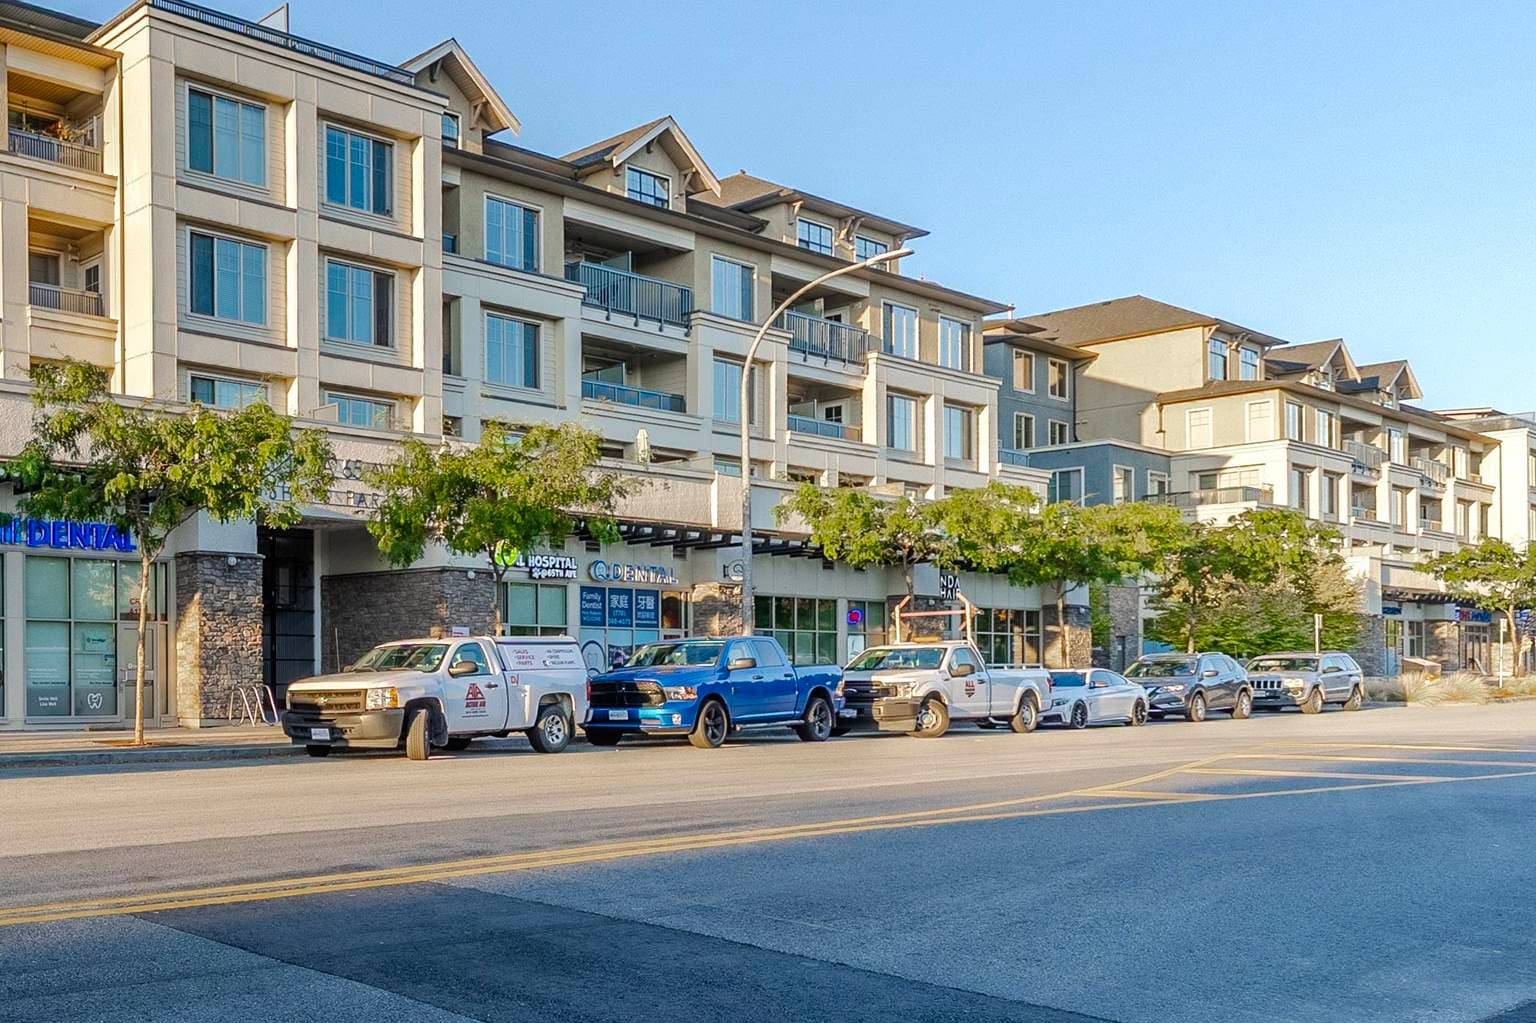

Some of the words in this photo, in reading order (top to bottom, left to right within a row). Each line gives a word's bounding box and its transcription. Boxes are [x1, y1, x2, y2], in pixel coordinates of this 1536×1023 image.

[26, 519, 137, 553] DENTAL
[528, 555, 578, 570] HOSPITAL
[611, 563, 679, 585] DENTAL
[582, 591, 602, 602] Family
[609, 594, 629, 609] 家庭
[581, 600, 602, 609] Dentist
